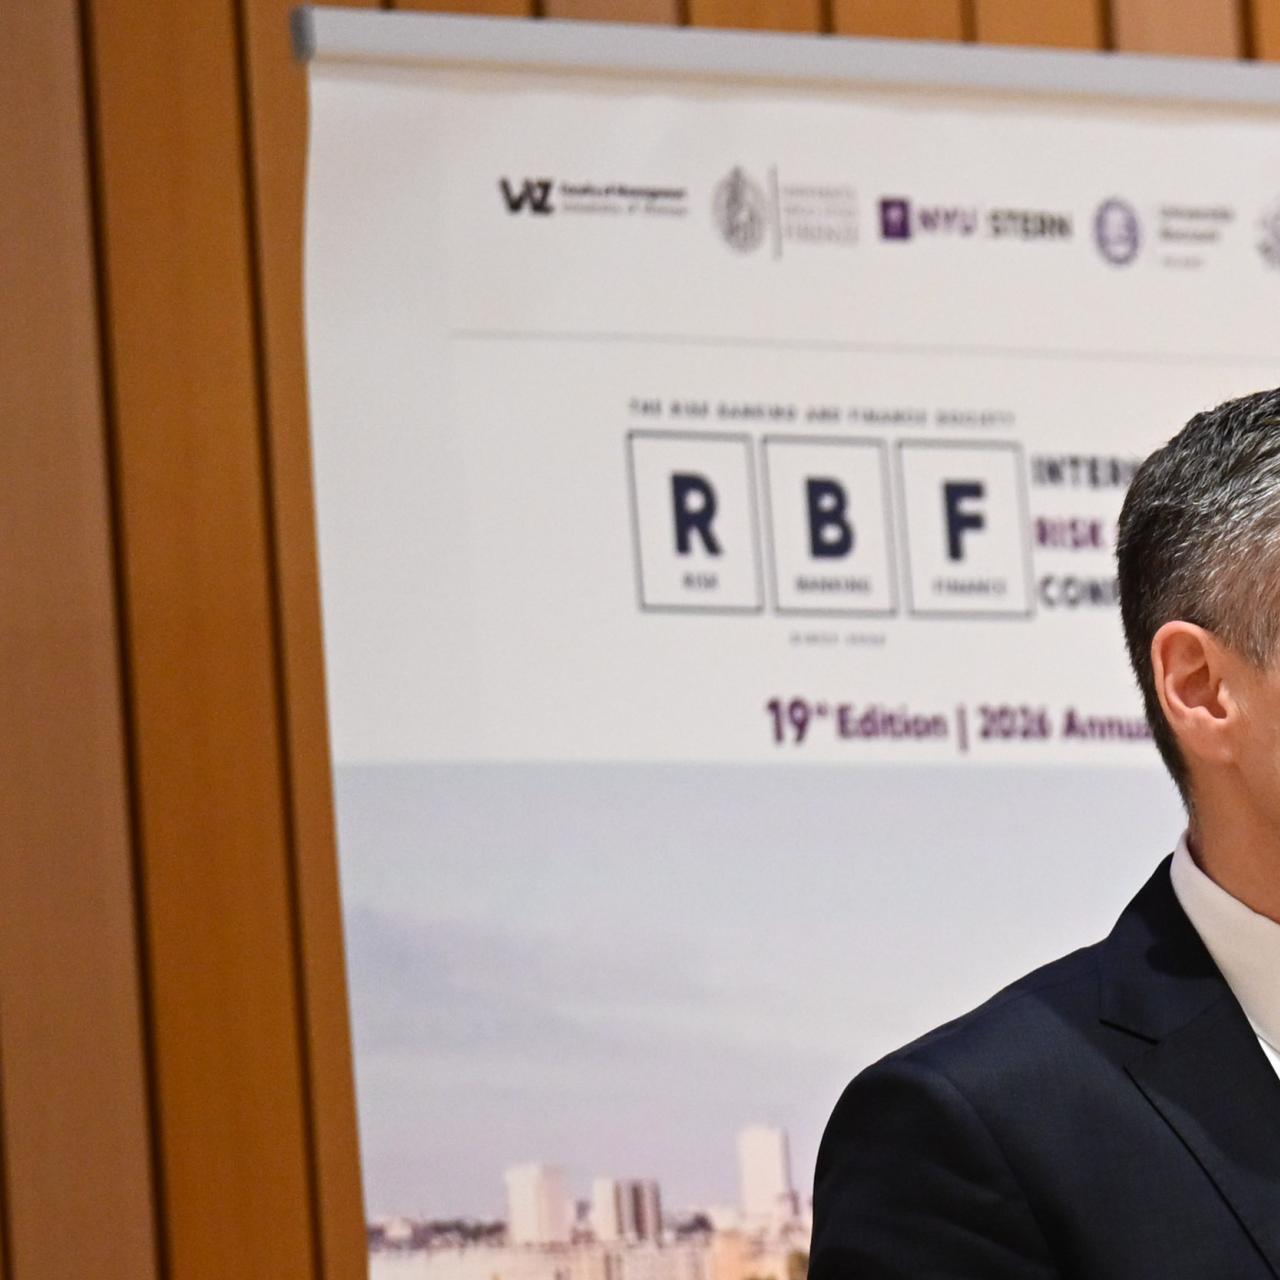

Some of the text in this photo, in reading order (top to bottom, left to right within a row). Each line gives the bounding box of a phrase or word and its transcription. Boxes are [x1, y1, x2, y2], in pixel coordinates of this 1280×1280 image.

[499, 177, 555, 215] WZ
[917, 206, 1074, 239] NYU STERN
[669, 471, 986, 563] R B F
[1033, 514, 1104, 551] RISK
[836, 702, 948, 740] Edition
[978, 704, 1052, 741] 2026
